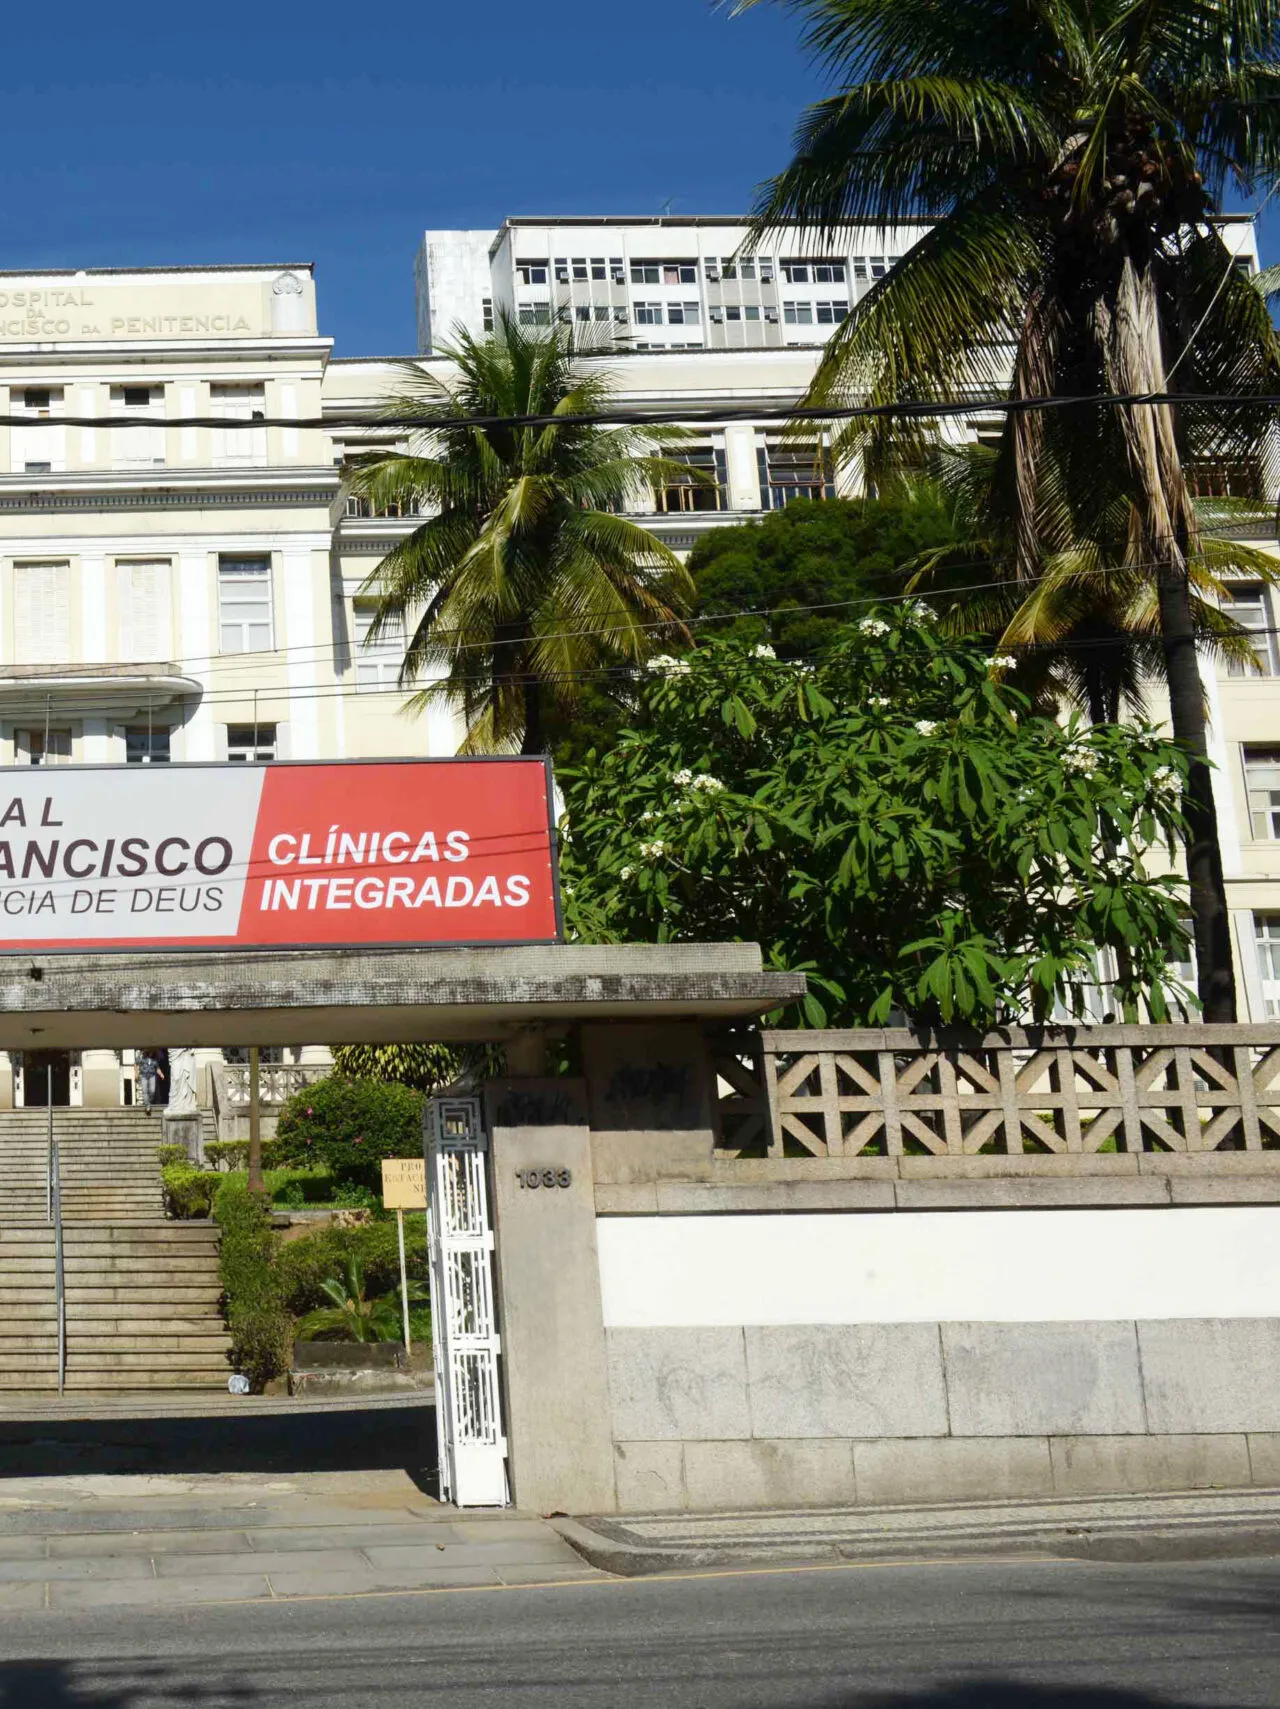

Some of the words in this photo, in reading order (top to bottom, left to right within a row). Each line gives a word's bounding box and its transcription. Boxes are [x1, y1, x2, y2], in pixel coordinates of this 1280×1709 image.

[26, 308, 46, 319] DA
[80, 325, 101, 335] DA
[110, 315, 250, 334] PENITENCIA
[268, 824, 470, 866] CLÍNICAS
[71, 890, 117, 914] DE
[131, 887, 223, 913] DEUS
[260, 874, 531, 911] INTEGRADAS
[515, 1167, 571, 1190] 1033
